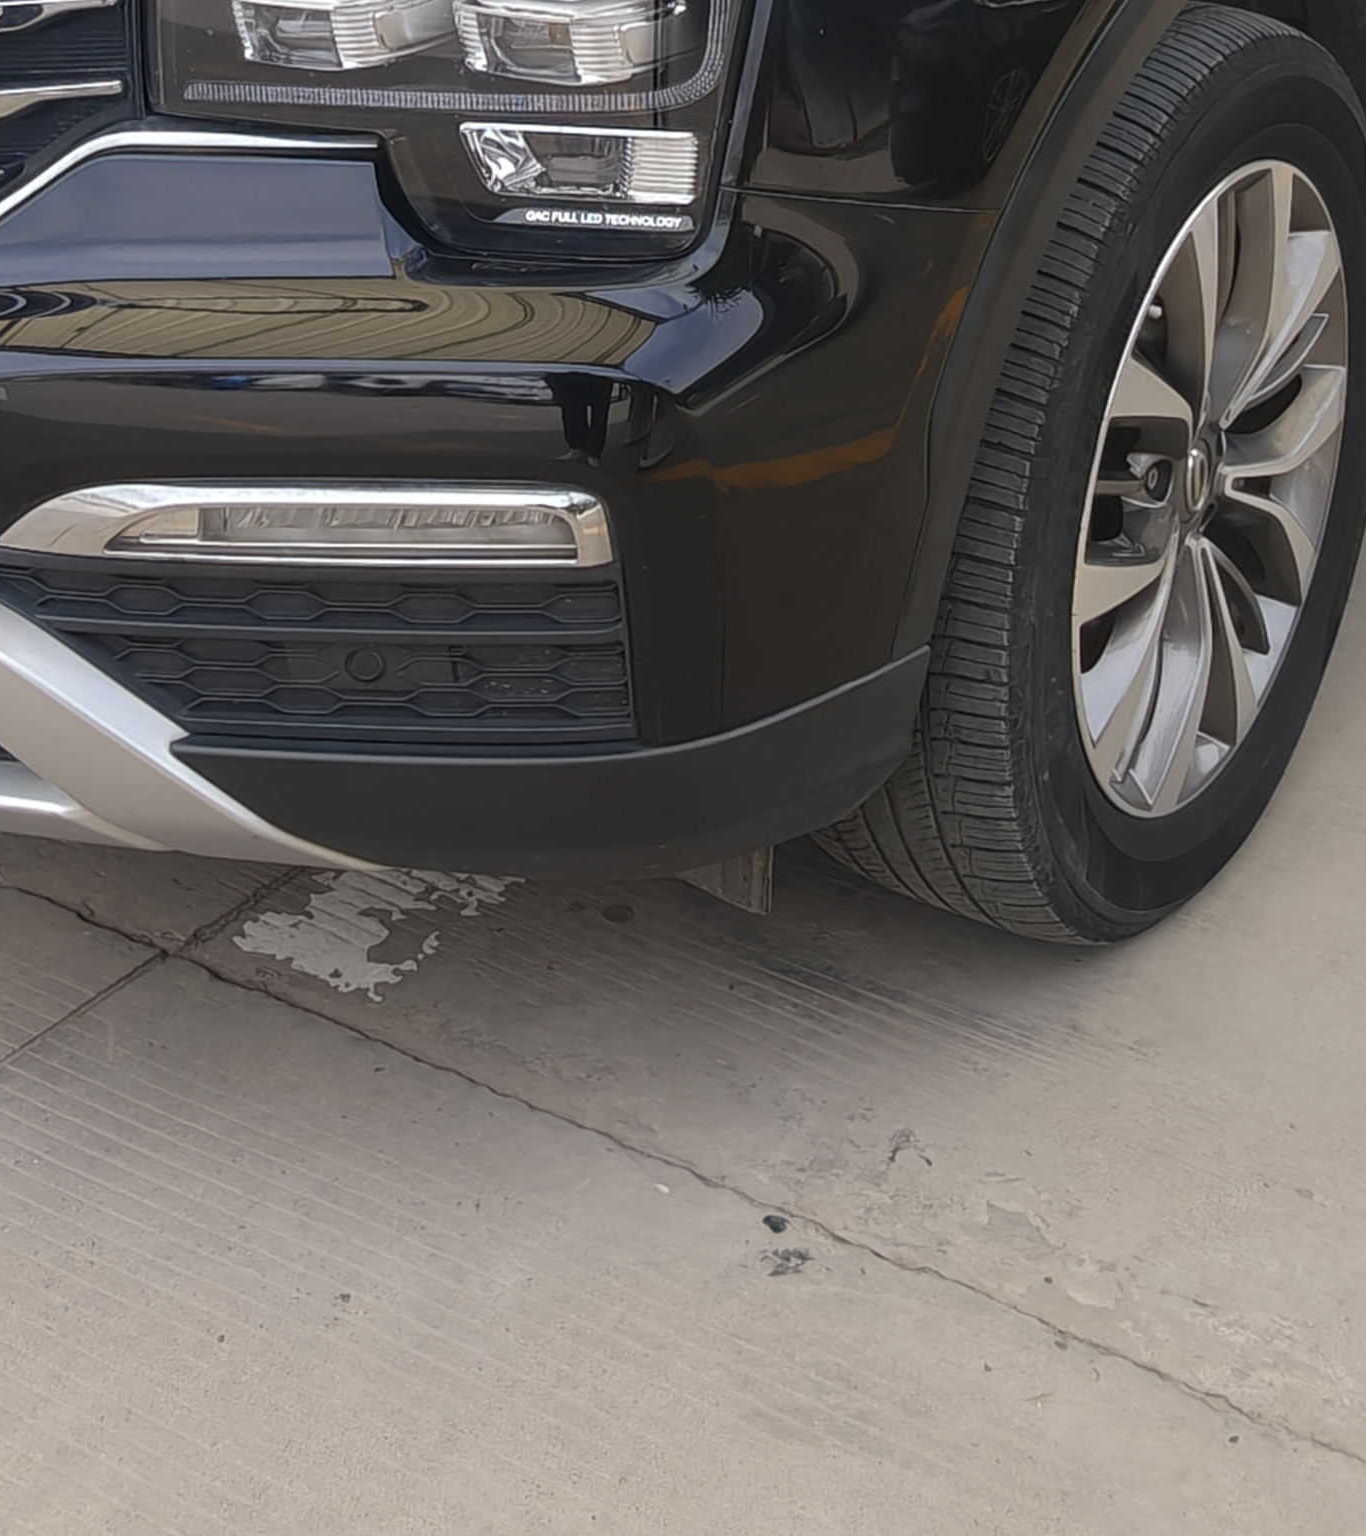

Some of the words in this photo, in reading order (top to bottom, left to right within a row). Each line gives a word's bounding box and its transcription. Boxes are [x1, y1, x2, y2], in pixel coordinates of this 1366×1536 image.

[525, 210, 550, 222] GAC
[551, 211, 578, 223] FULL
[580, 212, 602, 225] LED
[604, 213, 683, 229] TECHNOLOGY
